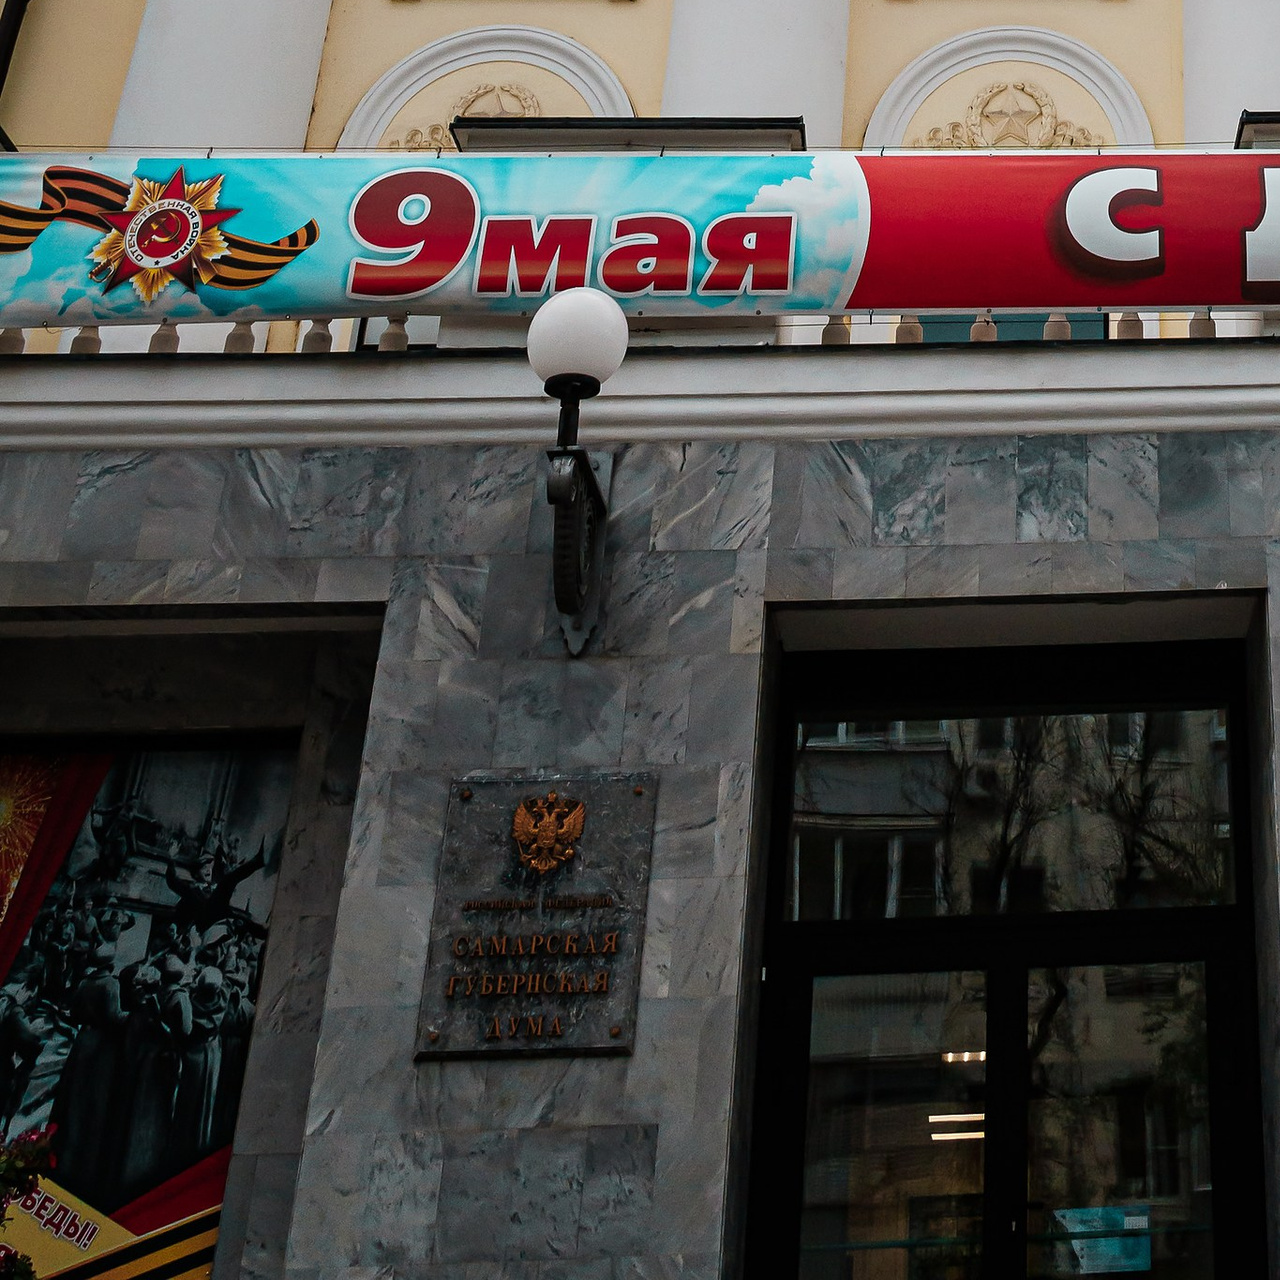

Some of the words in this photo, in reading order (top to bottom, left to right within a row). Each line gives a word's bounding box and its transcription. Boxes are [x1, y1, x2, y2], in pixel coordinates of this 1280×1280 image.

[127, 200, 198, 262] ОТЕЧЕСТВЕННАЯ
[453, 931, 619, 957] САМАРСКАЯ
[446, 971, 610, 999] ГУБЕРНСКАЯ
[485, 1015, 564, 1041] ДУМА
[11, 1188, 100, 1251] БЕДЫ!
